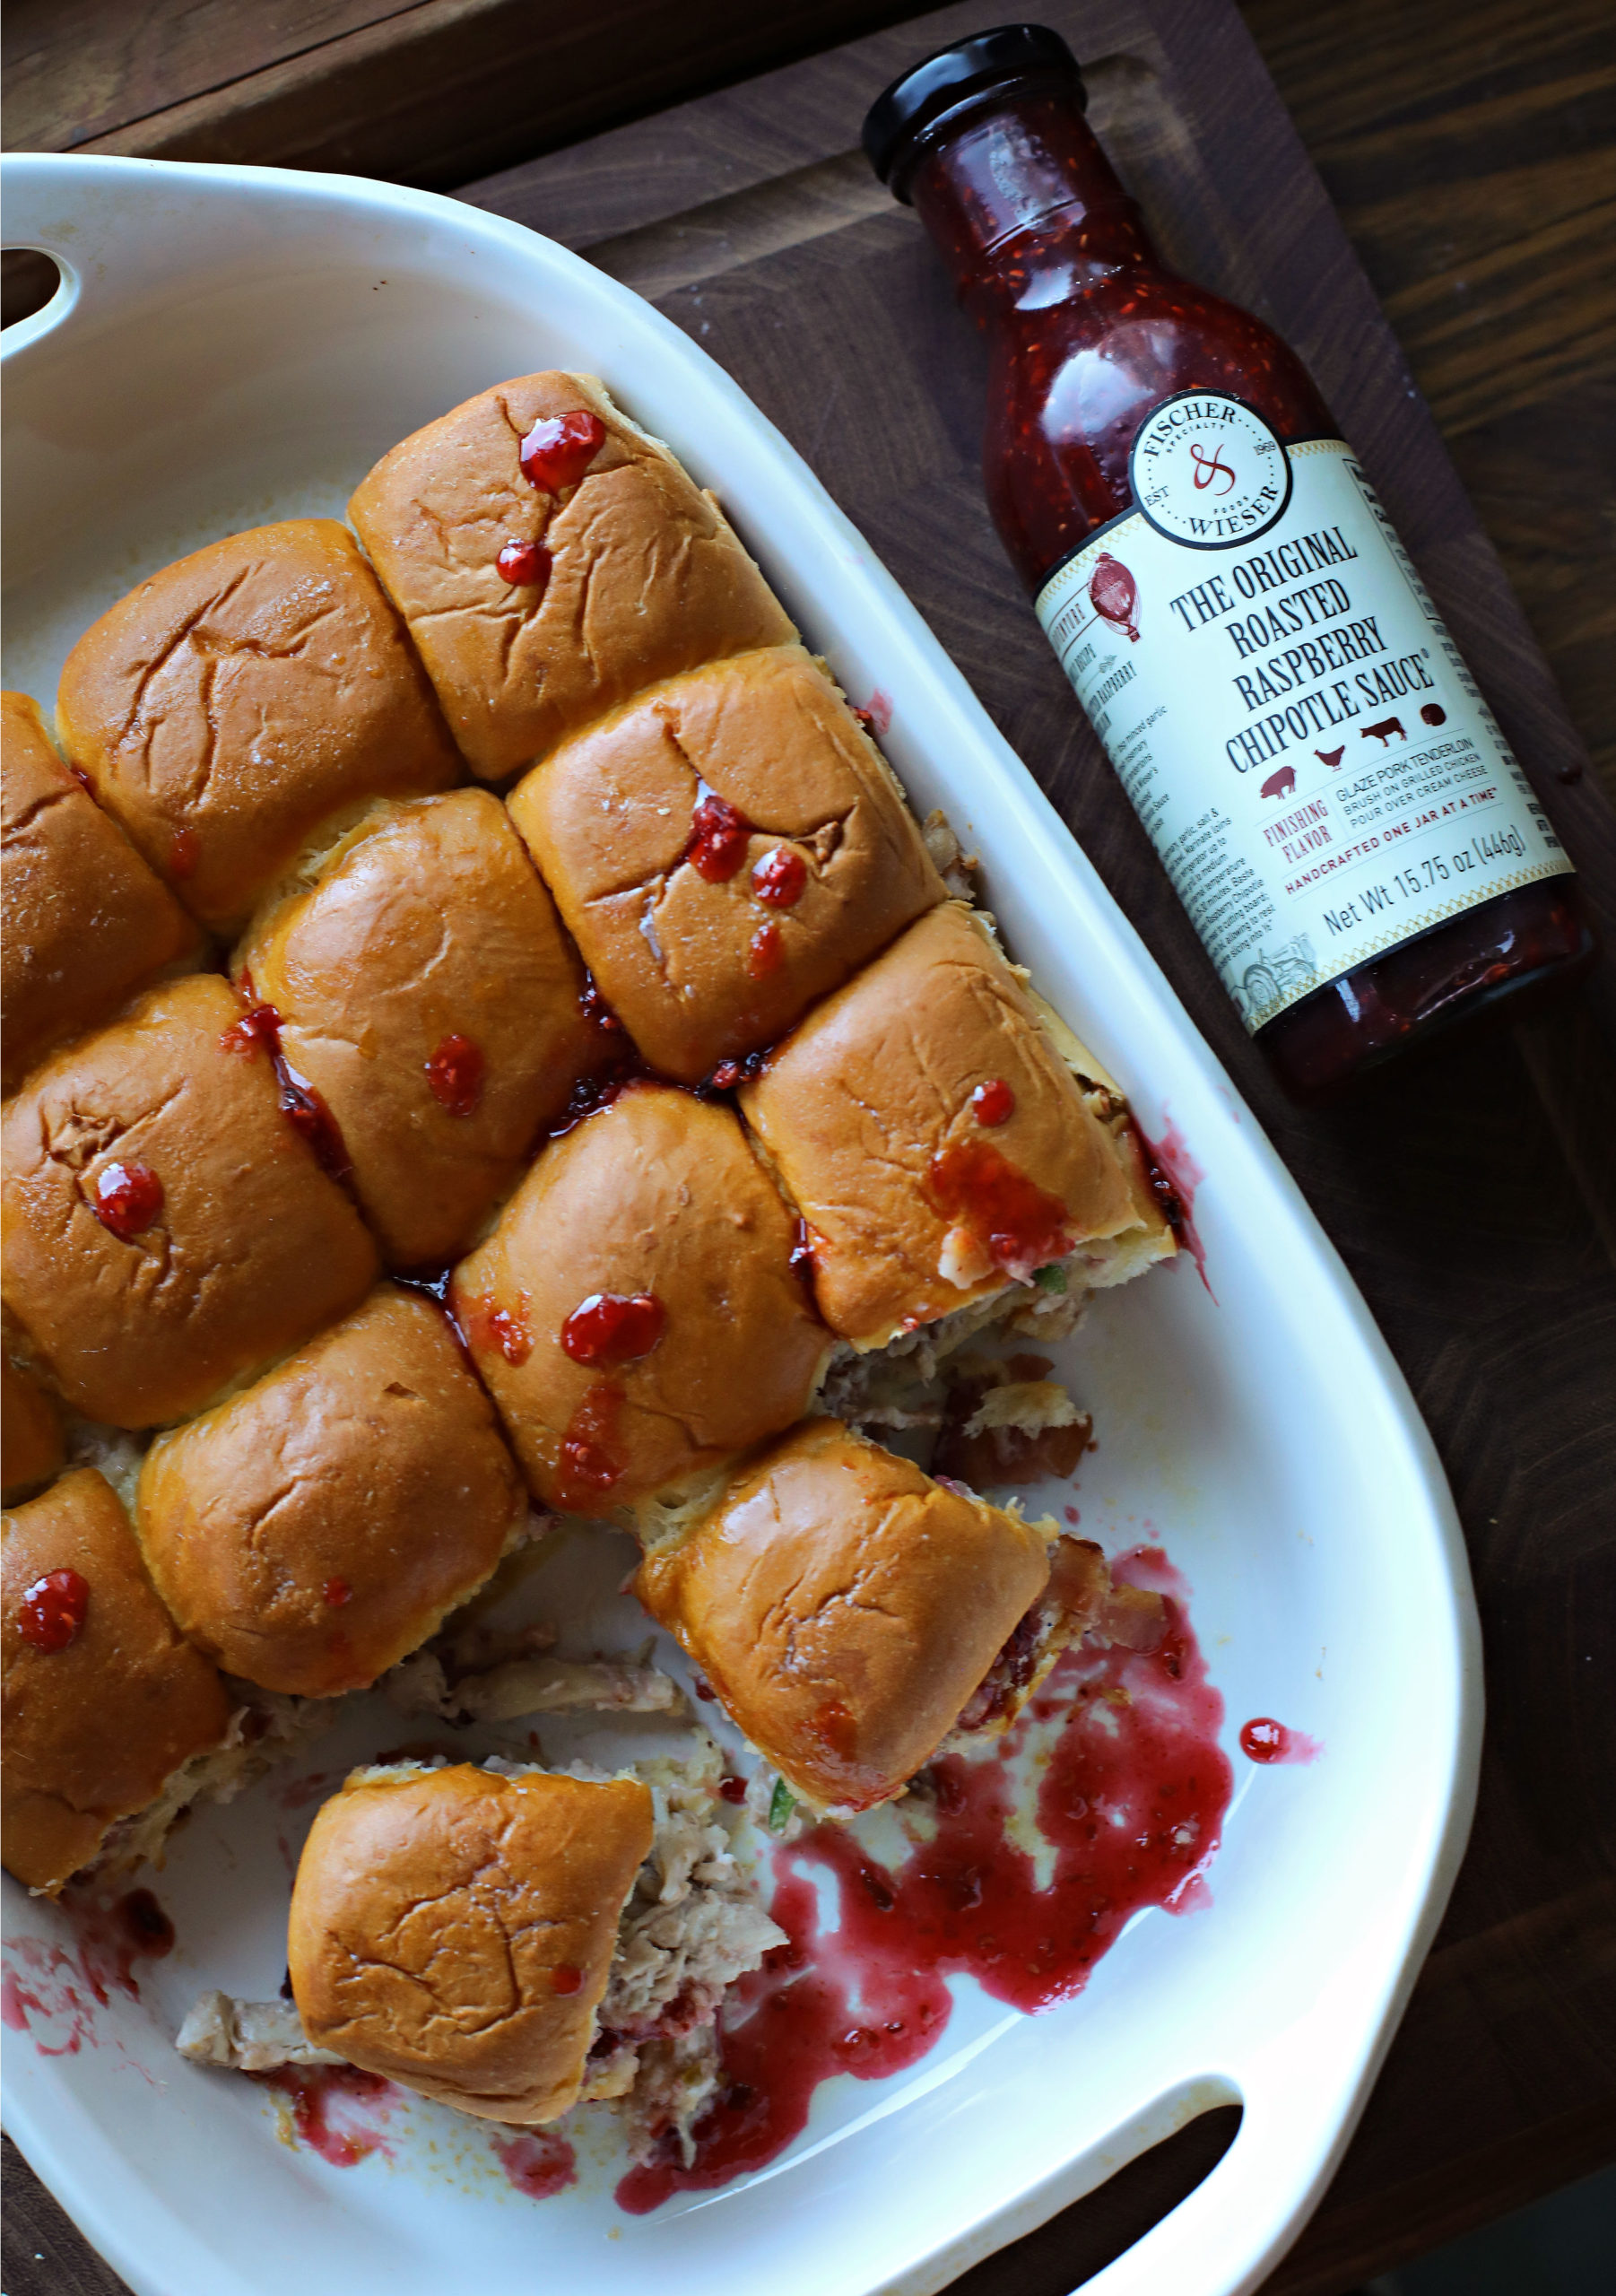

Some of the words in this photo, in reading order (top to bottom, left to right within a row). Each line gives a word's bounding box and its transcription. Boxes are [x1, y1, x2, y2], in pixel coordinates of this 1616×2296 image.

[1143, 402, 1236, 458] FISCHER
[1167, 422, 1226, 454] SPECIALTY
[1253, 440, 1277, 456] 1969
[1190, 443, 1236, 496] &
[1144, 485, 1170, 508] EST
[1187, 485, 1280, 536] WIESER
[1213, 495, 1249, 515] FOODS
[1169, 575, 1237, 632] THE
[1232, 526, 1359, 599] ORIGINAL
[1225, 578, 1351, 660] ROASTED
[1232, 616, 1388, 712] RASPBERRY
[1226, 681, 1360, 773] CHIPOTLE
[1335, 775, 1377, 802] GLAZE
[1376, 758, 1412, 785] PORK
[1410, 737, 1475, 768] TENDERLOIN
[1344, 791, 1381, 815] BRUSH
[1382, 783, 1400, 796] ON
[1402, 764, 1444, 789] GRILLED
[1443, 752, 1481, 772] CHICKEN
[1351, 808, 1384, 829] POUR
[1386, 793, 1415, 813] OVER
[1416, 777, 1452, 798] CREAM
[1453, 765, 1489, 784] CHEESE
[1217, 837, 1228, 847] to
[1263, 799, 1329, 848] FINISHING
[1281, 824, 1334, 864] FLAVOR
[1285, 837, 1381, 895] HANDCRAFTED
[1383, 822, 1412, 841] ONE
[1415, 810, 1439, 829] JAR
[1442, 801, 1457, 816] AT
[1459, 798, 1469, 810] A
[1204, 857, 1247, 891] temperature
[1230, 868, 1255, 887] Baste
[1231, 879, 1265, 904] Chipotle
[1322, 901, 1363, 936] Net
[1359, 884, 1395, 915] Wt
[1393, 856, 1451, 898] 15.75
[1452, 851, 1476, 873] oz
[1471, 824, 1526, 865] (446g)
[1249, 916, 1259, 926] to
[1258, 904, 1276, 920] rest
